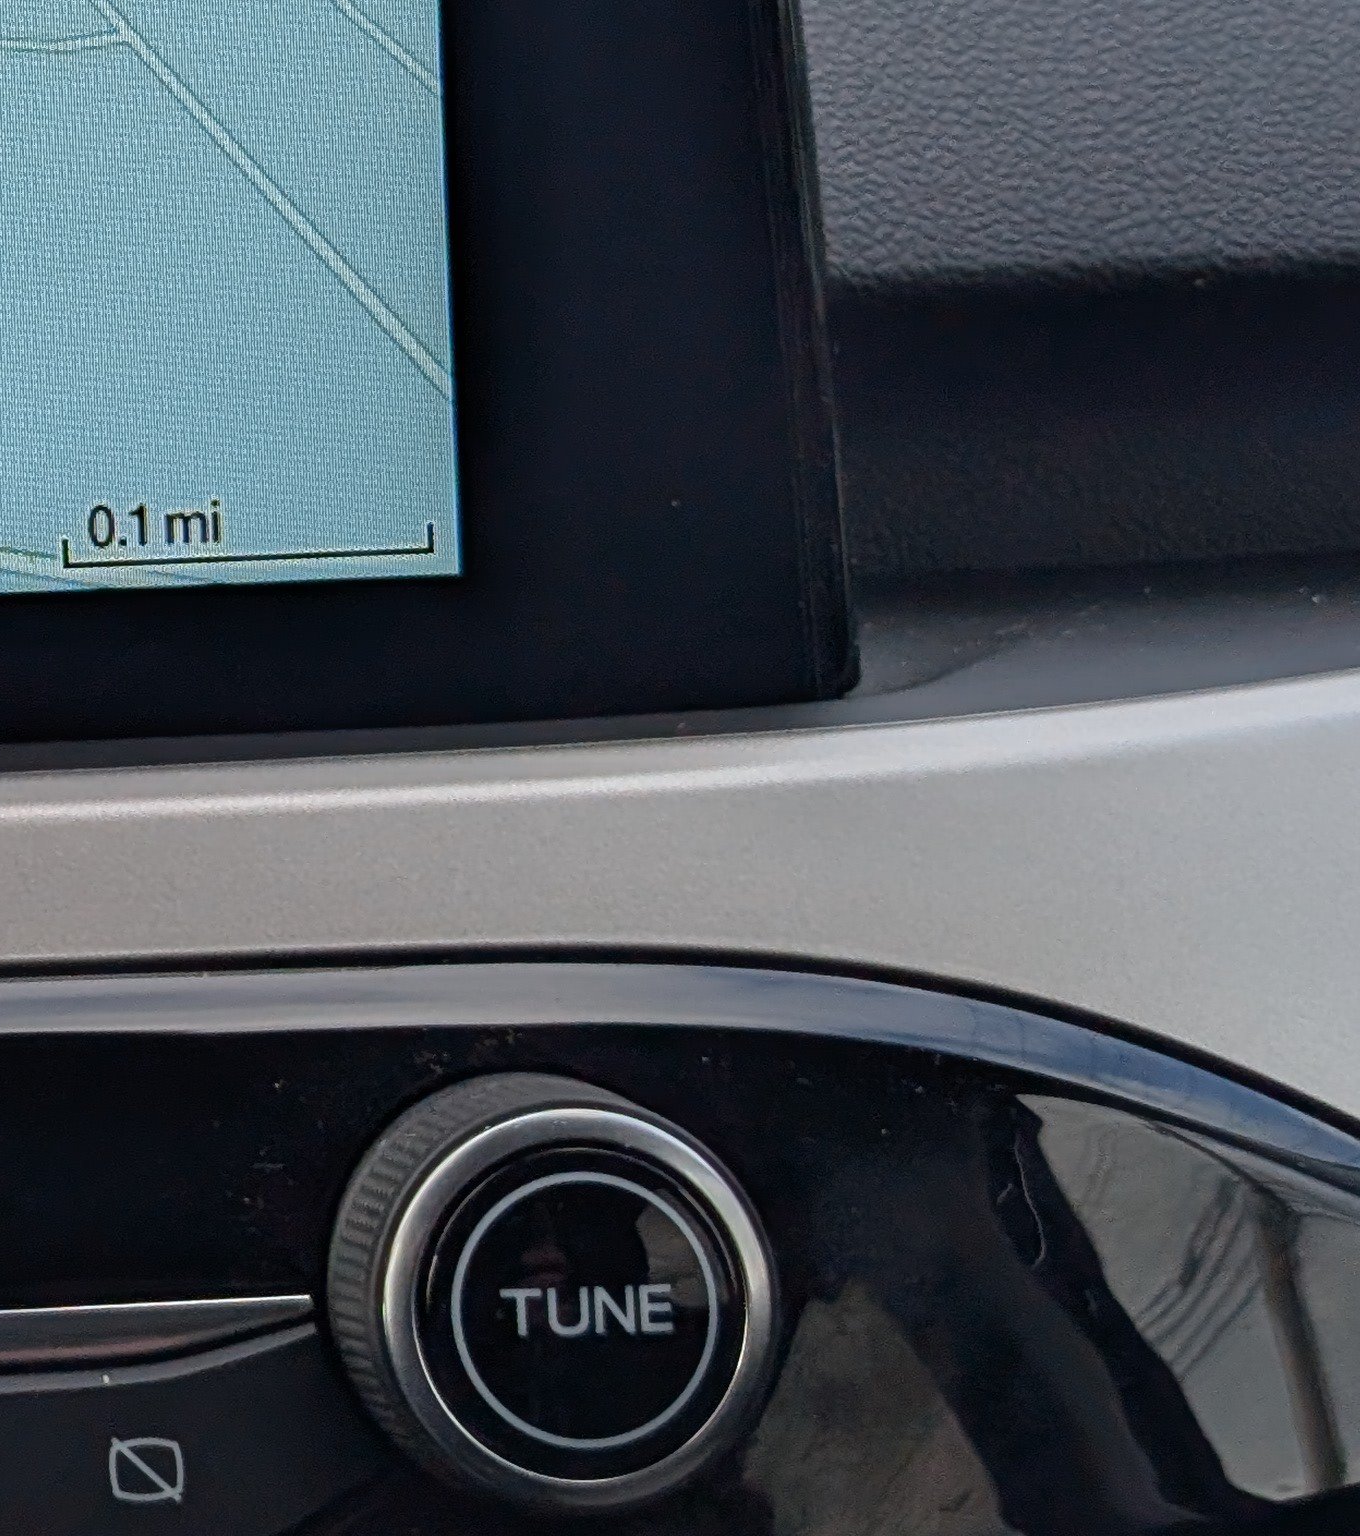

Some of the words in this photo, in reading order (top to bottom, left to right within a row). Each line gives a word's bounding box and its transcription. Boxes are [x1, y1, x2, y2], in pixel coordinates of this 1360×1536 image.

[86, 502, 148, 549] 0.1
[164, 498, 224, 545] mi
[499, 1282, 675, 1338] TUNE
